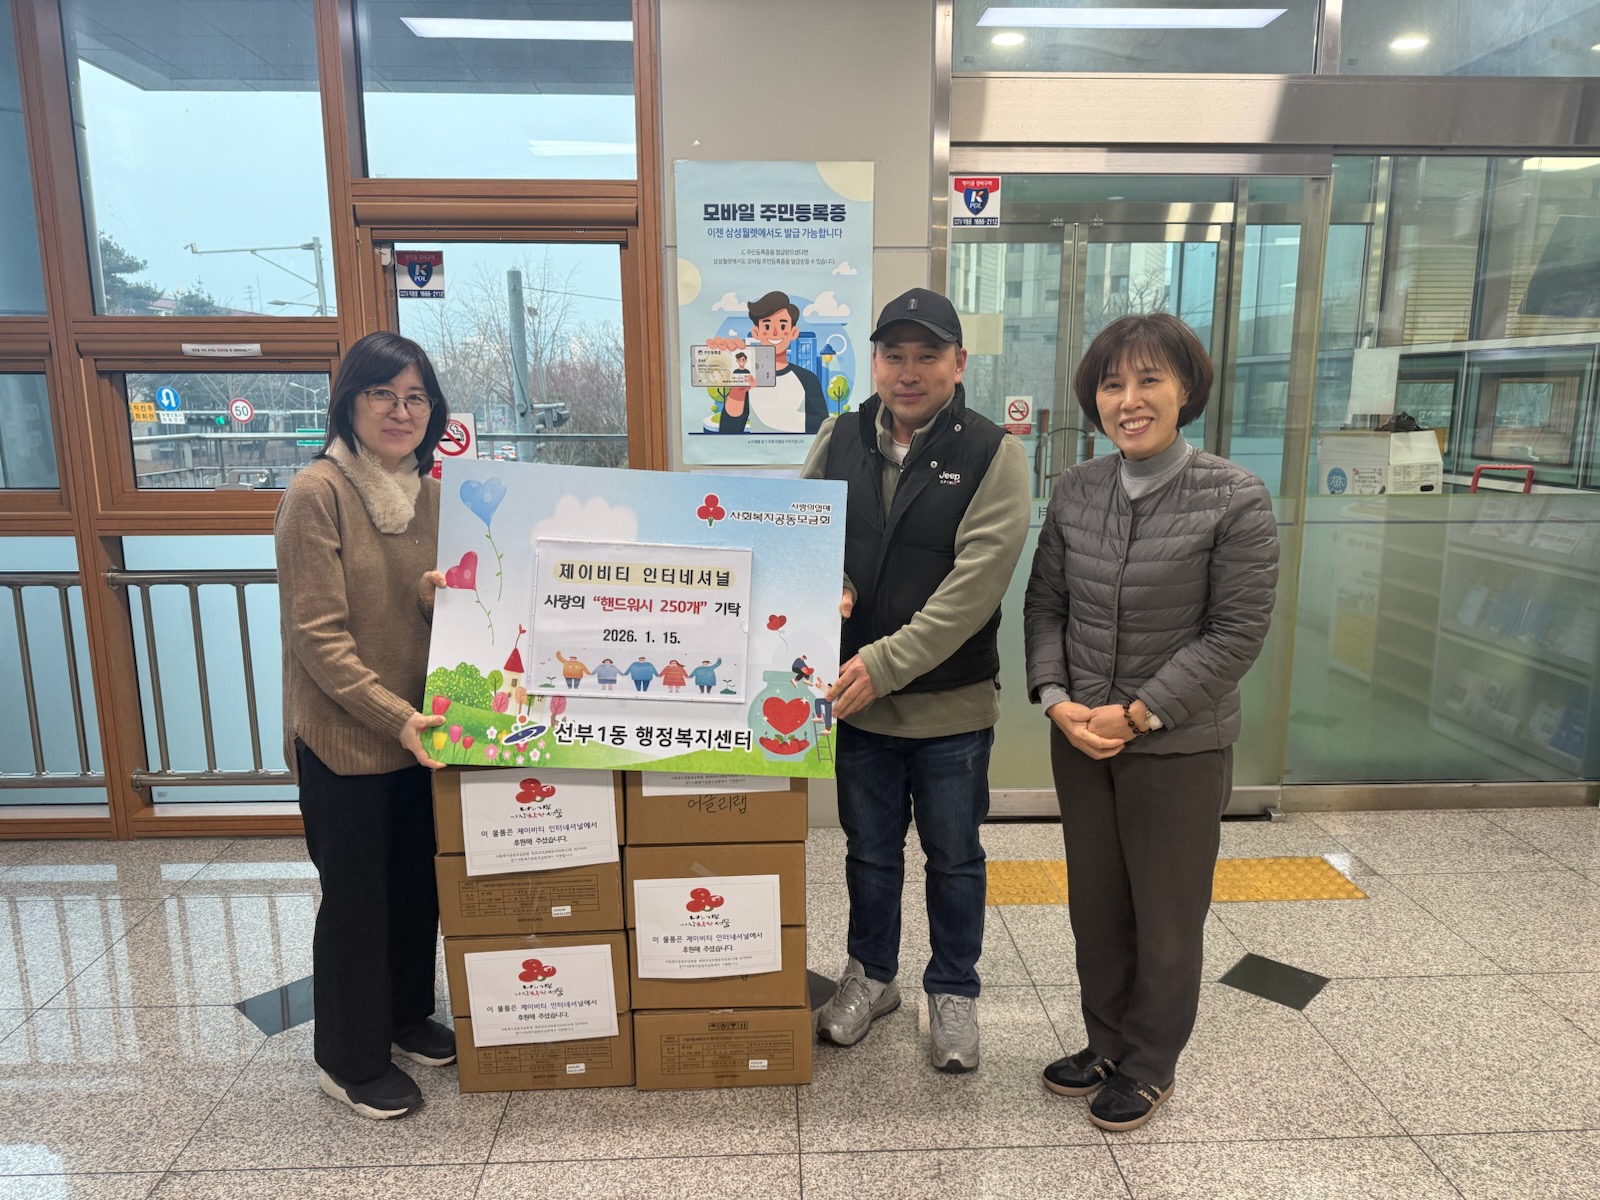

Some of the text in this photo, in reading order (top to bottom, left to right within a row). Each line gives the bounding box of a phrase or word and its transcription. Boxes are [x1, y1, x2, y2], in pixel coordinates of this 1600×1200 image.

[970, 190, 984, 202] K
[703, 203, 846, 222] 모바일 주민등록증
[708, 228, 842, 238] 이젠 삼성월렛에서도 발급 가능합니다
[234, 406, 248, 416] 50
[938, 470, 960, 480] Jeep
[790, 503, 831, 512] 사랑의열매
[730, 511, 830, 526] 사회복지공동모금회
[559, 563, 730, 587] 제이비티 인터네셔널
[544, 594, 741, 616] 사랑의 “핸드워시 250개” 기탁
[602, 629, 680, 644] 2026. 1. 15.
[555, 722, 752, 750] 선부1동 행정복지센터
[492, 828, 514, 838] 물품은
[516, 825, 545, 834] 제이비티
[548, 821, 598, 833] 인터네셔널에서
[513, 835, 568, 846] 후원해 주셨습니다.
[662, 935, 683, 943] 물품은
[686, 934, 713, 943] 제이비티
[716, 931, 763, 942] 인터네셔널에서
[682, 944, 734, 954] 후원해 주셨습니다.
[498, 1004, 518, 1012] 물품은
[520, 1002, 548, 1011] 제이비티
[550, 999, 598, 1010] 인터네셔널에서
[538, 1012, 570, 1020] 주셨습니다.
